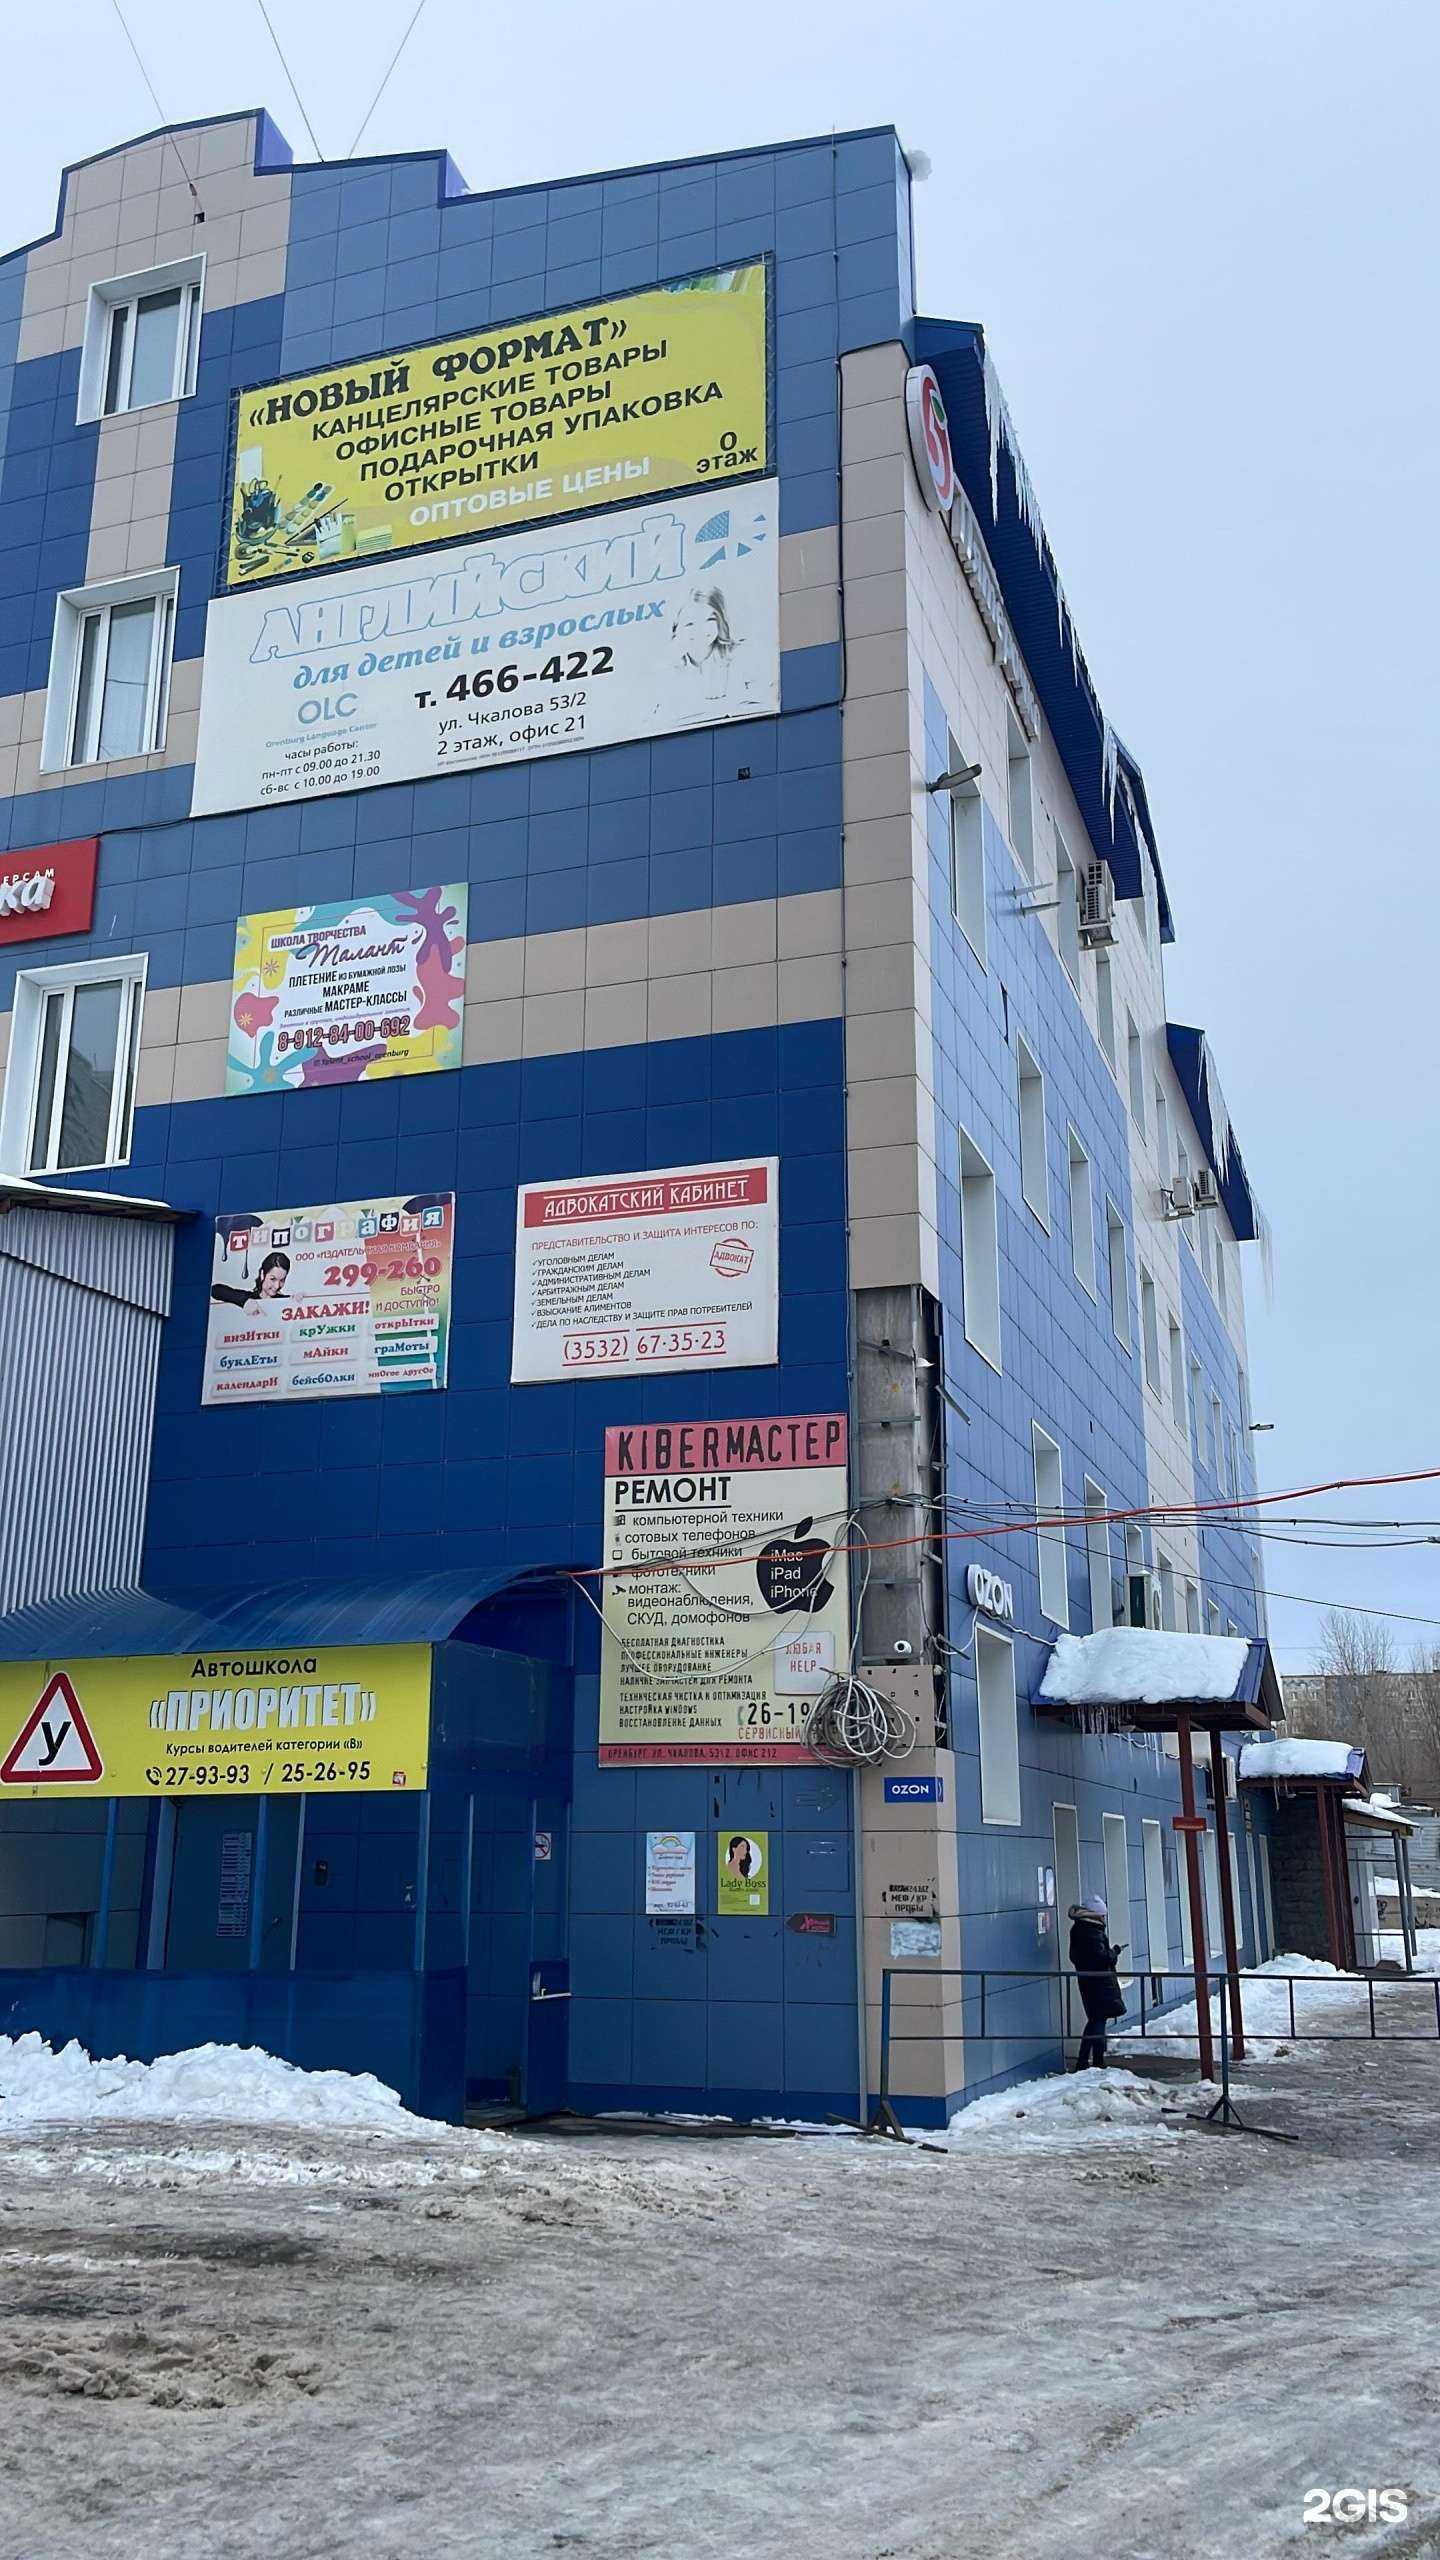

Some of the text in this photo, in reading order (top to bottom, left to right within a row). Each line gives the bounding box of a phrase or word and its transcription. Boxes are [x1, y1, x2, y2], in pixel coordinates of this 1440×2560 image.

[248, 317, 628, 426] «НОВЫЙ ФОРМАТ»
[311, 339, 668, 440] КАНЦЕЛЯРСКИЕ ТОВАРЫ
[336, 381, 612, 461] ОФИСНЫЕ ТОВАРЫ
[360, 381, 723, 482] ПОДАРОЧНАЯ УПАКОВКА
[696, 446, 758, 475] этаж
[385, 451, 539, 501] ОТКРЫТКИ
[409, 457, 651, 526] ОПТОВЫЕ ЦЕНЫ
[293, 600, 667, 691] для детей и взрослых
[414, 646, 614, 709] т. 466-422
[297, 692, 359, 724] OLC
[438, 691, 587, 736] ул. Чкалова 53/2
[437, 740, 448, 756] 2
[452, 732, 504, 753] этаж,
[509, 722, 560, 742] офис
[564, 713, 587, 731] 21
[284, 740, 360, 761] часы работы:
[261, 749, 382, 781] пн-пт с 09.00 до 21.30
[260, 765, 381, 797] сб-вс с 10.00 до 19.00
[271, 925, 367, 949] ШКОЛА ТВОРЧЕСТВА
[295, 935, 409, 968] Талант
[288, 970, 338, 988] ПЛЕТЕНИЕ
[338, 972, 347, 981] ИЗ
[348, 967, 387, 981] БУМАЖНОЙ
[322, 981, 370, 998] МАКРАМЕ
[284, 1005, 323, 1018] РАЗЛИЧНЫЕ
[324, 989, 408, 1013] МАСТЕР-КЛАССЫ
[277, 1014, 411, 1052] 8-912-84-00-692
[544, 1178, 749, 1218] АДВОКАТСКИЙ КАБИНЕТ
[230, 1206, 444, 1251] типография
[531, 1220, 759, 1251] ПРЕДСТАВИТЕЛЬСТВО И ЗАЩИТА ИНТЕРЕСОВ ПО:
[536, 1252, 615, 1267] УГОЛОВНЫМ ДЕЛАМ
[537, 1261, 624, 1277] ГРАЖДАНСКИМ ДЕЛАМ
[714, 1250, 750, 1266] АДВОКАТ
[322, 1256, 442, 1288] 299-260
[537, 1269, 651, 1288] АДМИНИСТРАТИВНЫМ ДЕЛАМ
[400, 1283, 441, 1297] БЫСТРО
[536, 1293, 614, 1308] ЗЕМЕЛЬНЫМ ДЕЛАМ
[537, 1281, 625, 1297] АРБИТРАЖНЫМ ДЕЛАМ
[281, 1300, 371, 1322] ЗАКАЖИ!
[536, 1301, 632, 1317] ВЗЫСКАНИЕ АЛИМЕНТОВ
[536, 1300, 754, 1330] ДЕЛА ПО НАСЛЕДСТВУ И ЗАЩИТЕ ПРАВ ПОТРЕБИТЕЛЕЙ
[563, 1336, 629, 1361] (3532)
[615, 1475, 732, 1505] РЕМОНТ
[632, 1510, 785, 1528] компьютерной техники
[624, 1528, 756, 1544] сотовых телефонов
[631, 1546, 743, 1561] бытовой техники
[770, 1567, 801, 1581] iPad
[628, 1582, 682, 1597] монтаж:
[967, 1563, 1014, 1621] OZON
[627, 1612, 751, 1628] СКУД, домофонов
[670, 1635, 725, 1648] ДИАГНОСТИКА
[703, 1648, 748, 1660] ИНЖЕНЕРЫ
[789, 1659, 817, 1673] HELP
[190, 1655, 318, 1679] Автошкола
[653, 1661, 712, 1673] ОБОРУДОВАНИЕ
[619, 1675, 653, 1686] НАЛИЧИЕ
[717, 1673, 753, 1685] РЕМОНТА
[149, 1682, 378, 1733] «ПРИОРИТЕТ»
[620, 1690, 767, 1702] ТЕХНИЧЕСКАЯ ЧИСТКА ОПТИМИЗАЦИЯ
[619, 1703, 698, 1715] НАСТРОЙКА WINDOWS
[619, 1717, 723, 1728] ВОССТАНОВЛЕНИЕ ДАННЫХ
[38, 1719, 73, 1767] У
[166, 1741, 207, 1756] Курсы
[207, 1737, 275, 1755] водителей
[275, 1737, 342, 1755] категории
[166, 1760, 371, 1786] 27-93-93 25-26-95
[891, 1784, 929, 1795] OZON
[720, 1877, 767, 1889] Lady Boss
